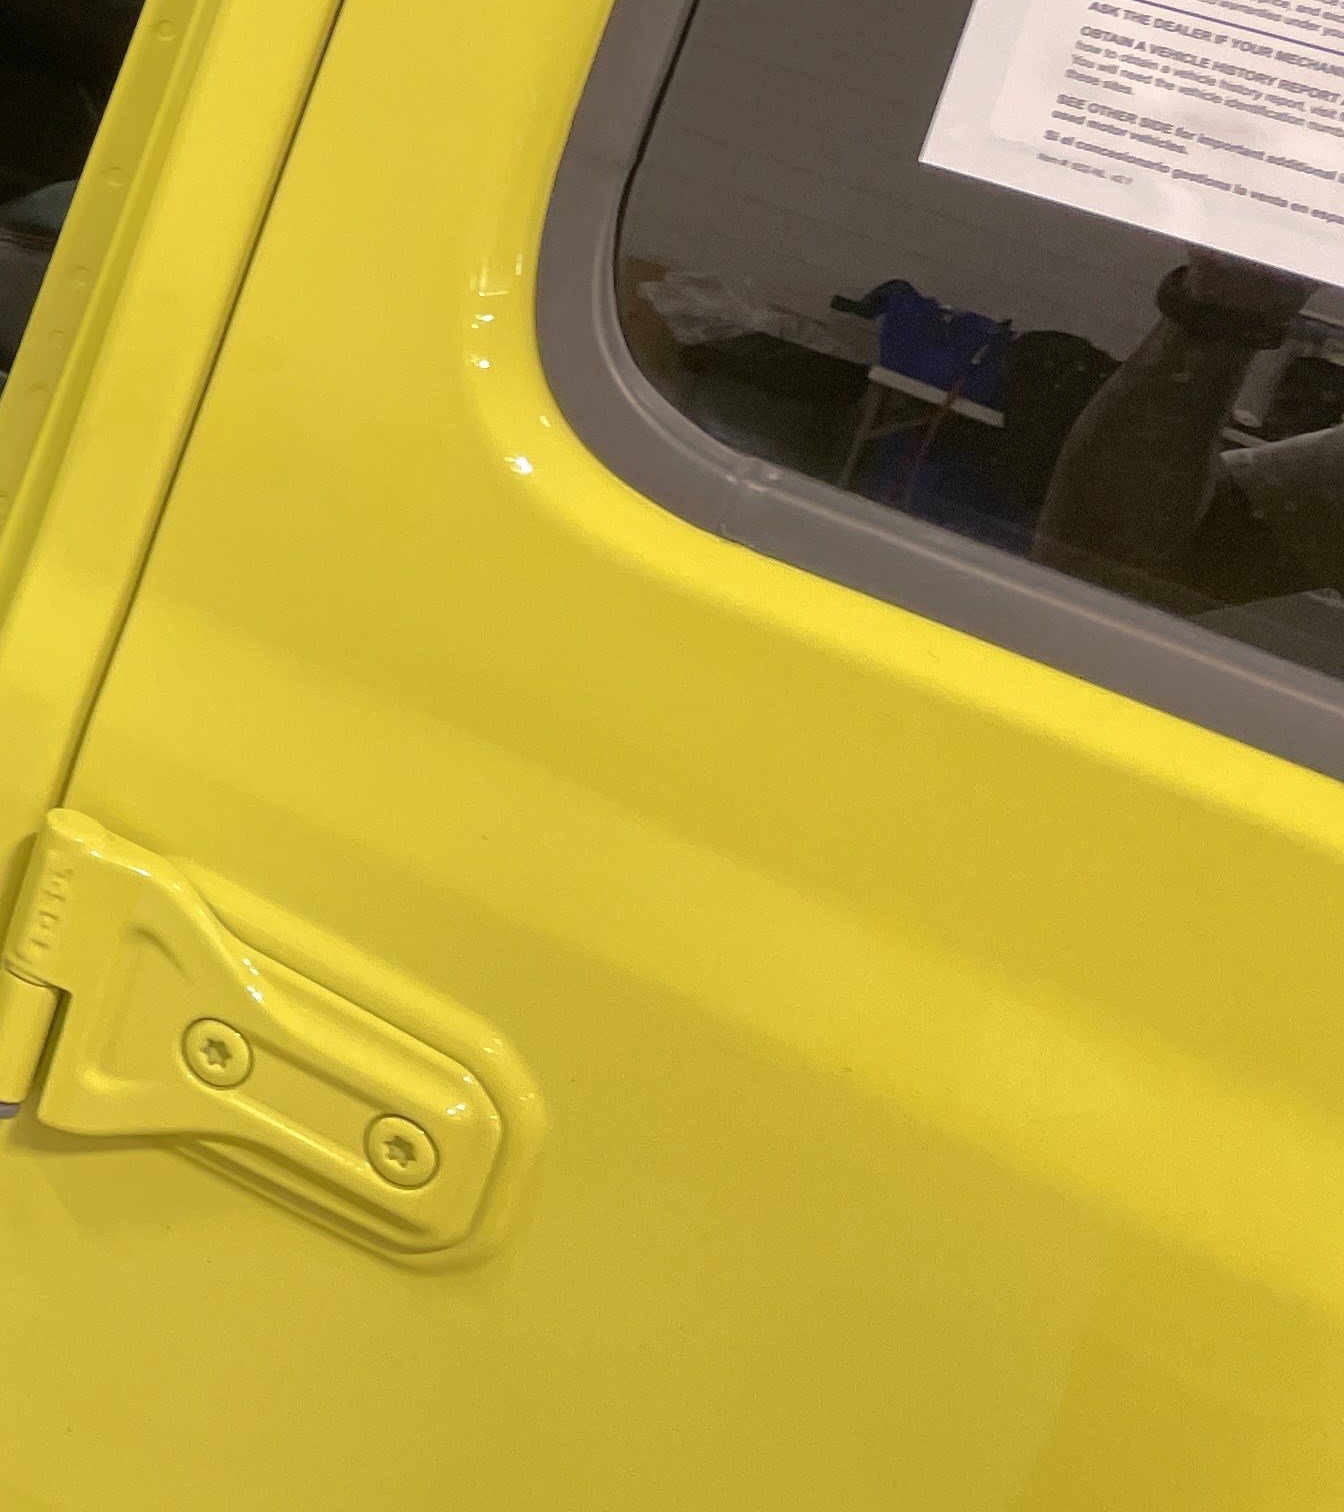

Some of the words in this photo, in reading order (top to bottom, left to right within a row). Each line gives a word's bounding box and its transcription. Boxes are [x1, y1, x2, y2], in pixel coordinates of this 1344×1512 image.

[1088, 2, 1121, 17] ASK
[1123, 10, 1151, 25] THE
[1153, 18, 1213, 42] DEALER
[1214, 35, 1229, 44] IF
[1232, 39, 1273, 58] YOUR
[1219, 0, 1282, 22] warranties
[1283, 17, 1322, 31] under
[1295, 5, 1321, 16] and
[1065, 69, 1100, 85] these
[1072, 54, 1095, 68] You
[1097, 64, 1119, 74] will
[1120, 70, 1153, 84] need
[1154, 78, 1175, 90] the
[1178, 86, 1223, 104] vehicle
[1224, 99, 1306, 126] identification
[1075, 41, 1102, 54] how
[1103, 49, 1118, 59] to
[1119, 54, 1159, 70] obtain
[1173, 69, 1217, 86] vehicle
[1219, 80, 1263, 100] history
[1080, 26, 1135, 47] OBTAIN
[1134, 42, 1146, 51] A
[1150, 44, 1211, 68] VEHICLE
[1211, 61, 1278, 85] HISTORY
[1278, 80, 1341, 103] REPORT
[1052, 111, 1086, 125] used
[1087, 120, 1129, 136] motor
[1057, 94, 1087, 110] SEE
[1087, 103, 1138, 124] OTHER
[1139, 118, 1174, 134] SIDE
[1174, 127, 1197, 140] for
[1197, 134, 1265, 160] important
[1265, 155, 1337, 180] additional
[1044, 130, 1059, 141] Si
[1060, 137, 1075, 146] el
[1075, 141, 1170, 173] concesionario
[1171, 169, 1232, 191] gestiona
[1233, 184, 1247, 196] la
[1250, 191, 1288, 207] venta
[1290, 203, 1309, 213] en
